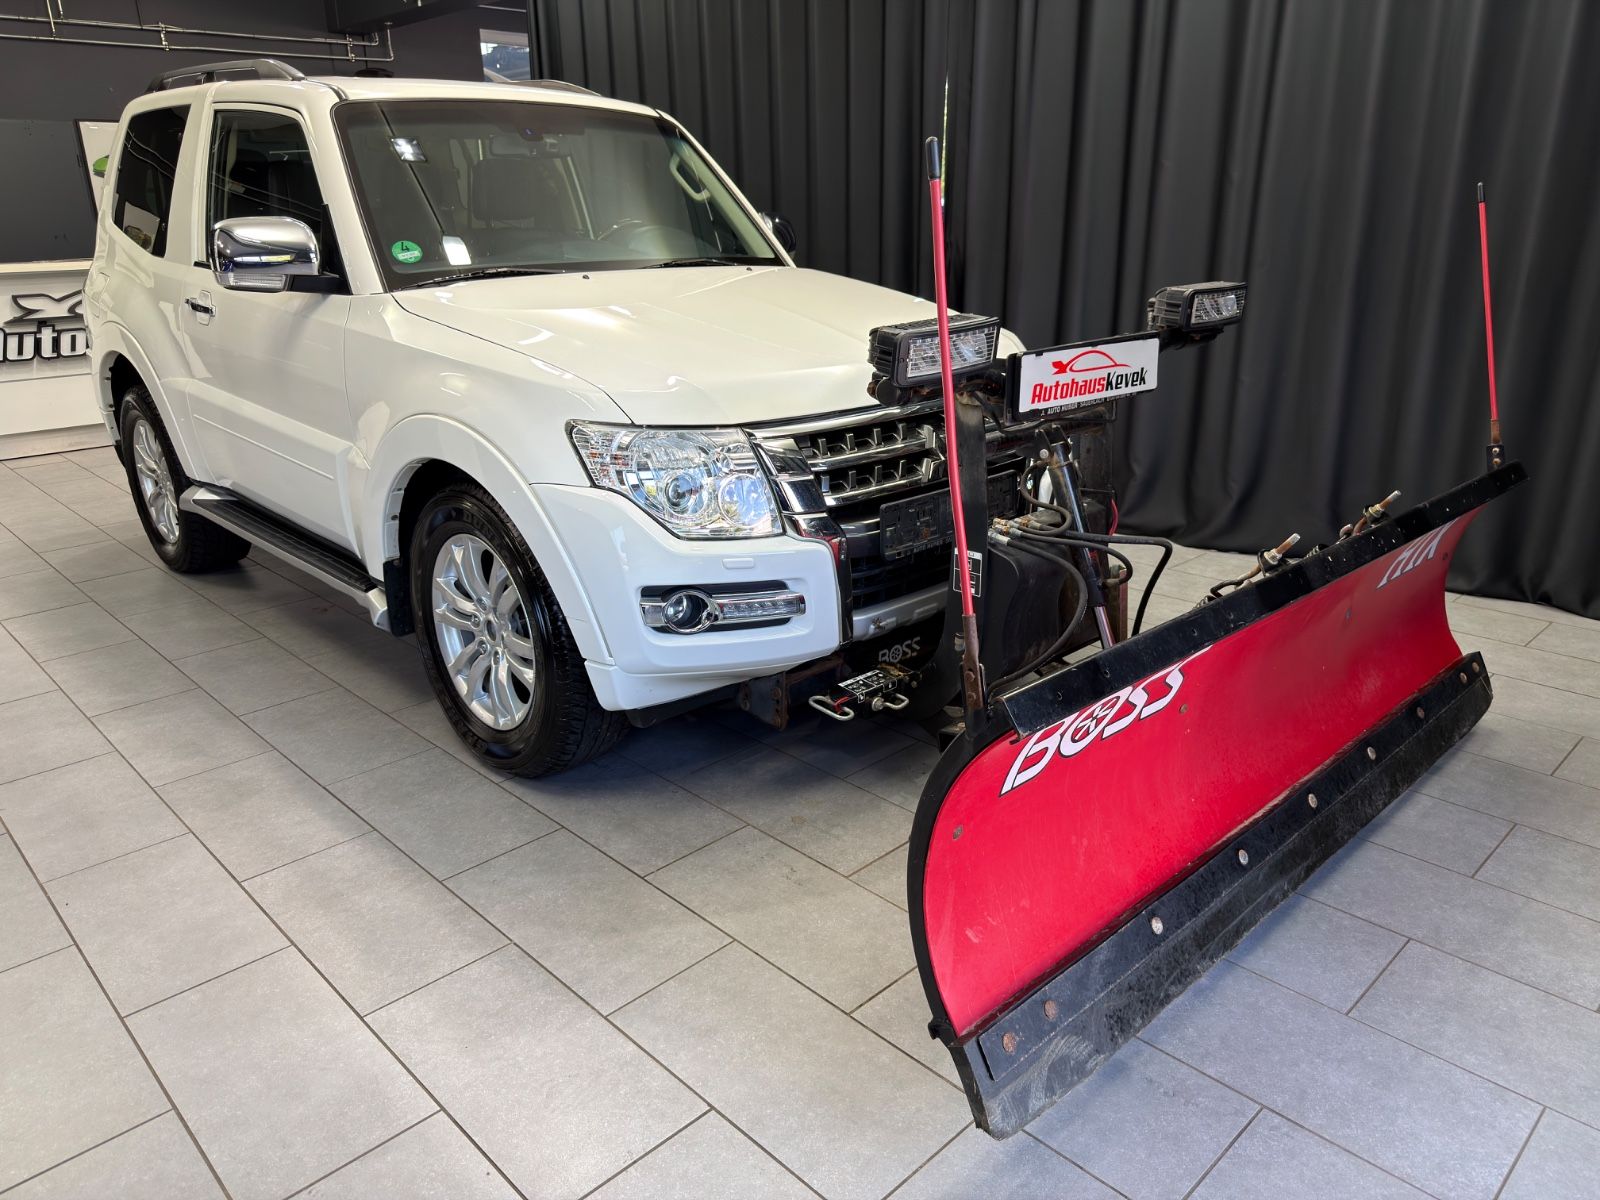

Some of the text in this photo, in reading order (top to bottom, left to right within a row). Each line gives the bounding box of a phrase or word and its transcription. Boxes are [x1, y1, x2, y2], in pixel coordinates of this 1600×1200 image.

[0, 324, 87, 361] uto
[1047, 406, 1061, 416] AUTO
[999, 644, 1213, 797] BOSS
